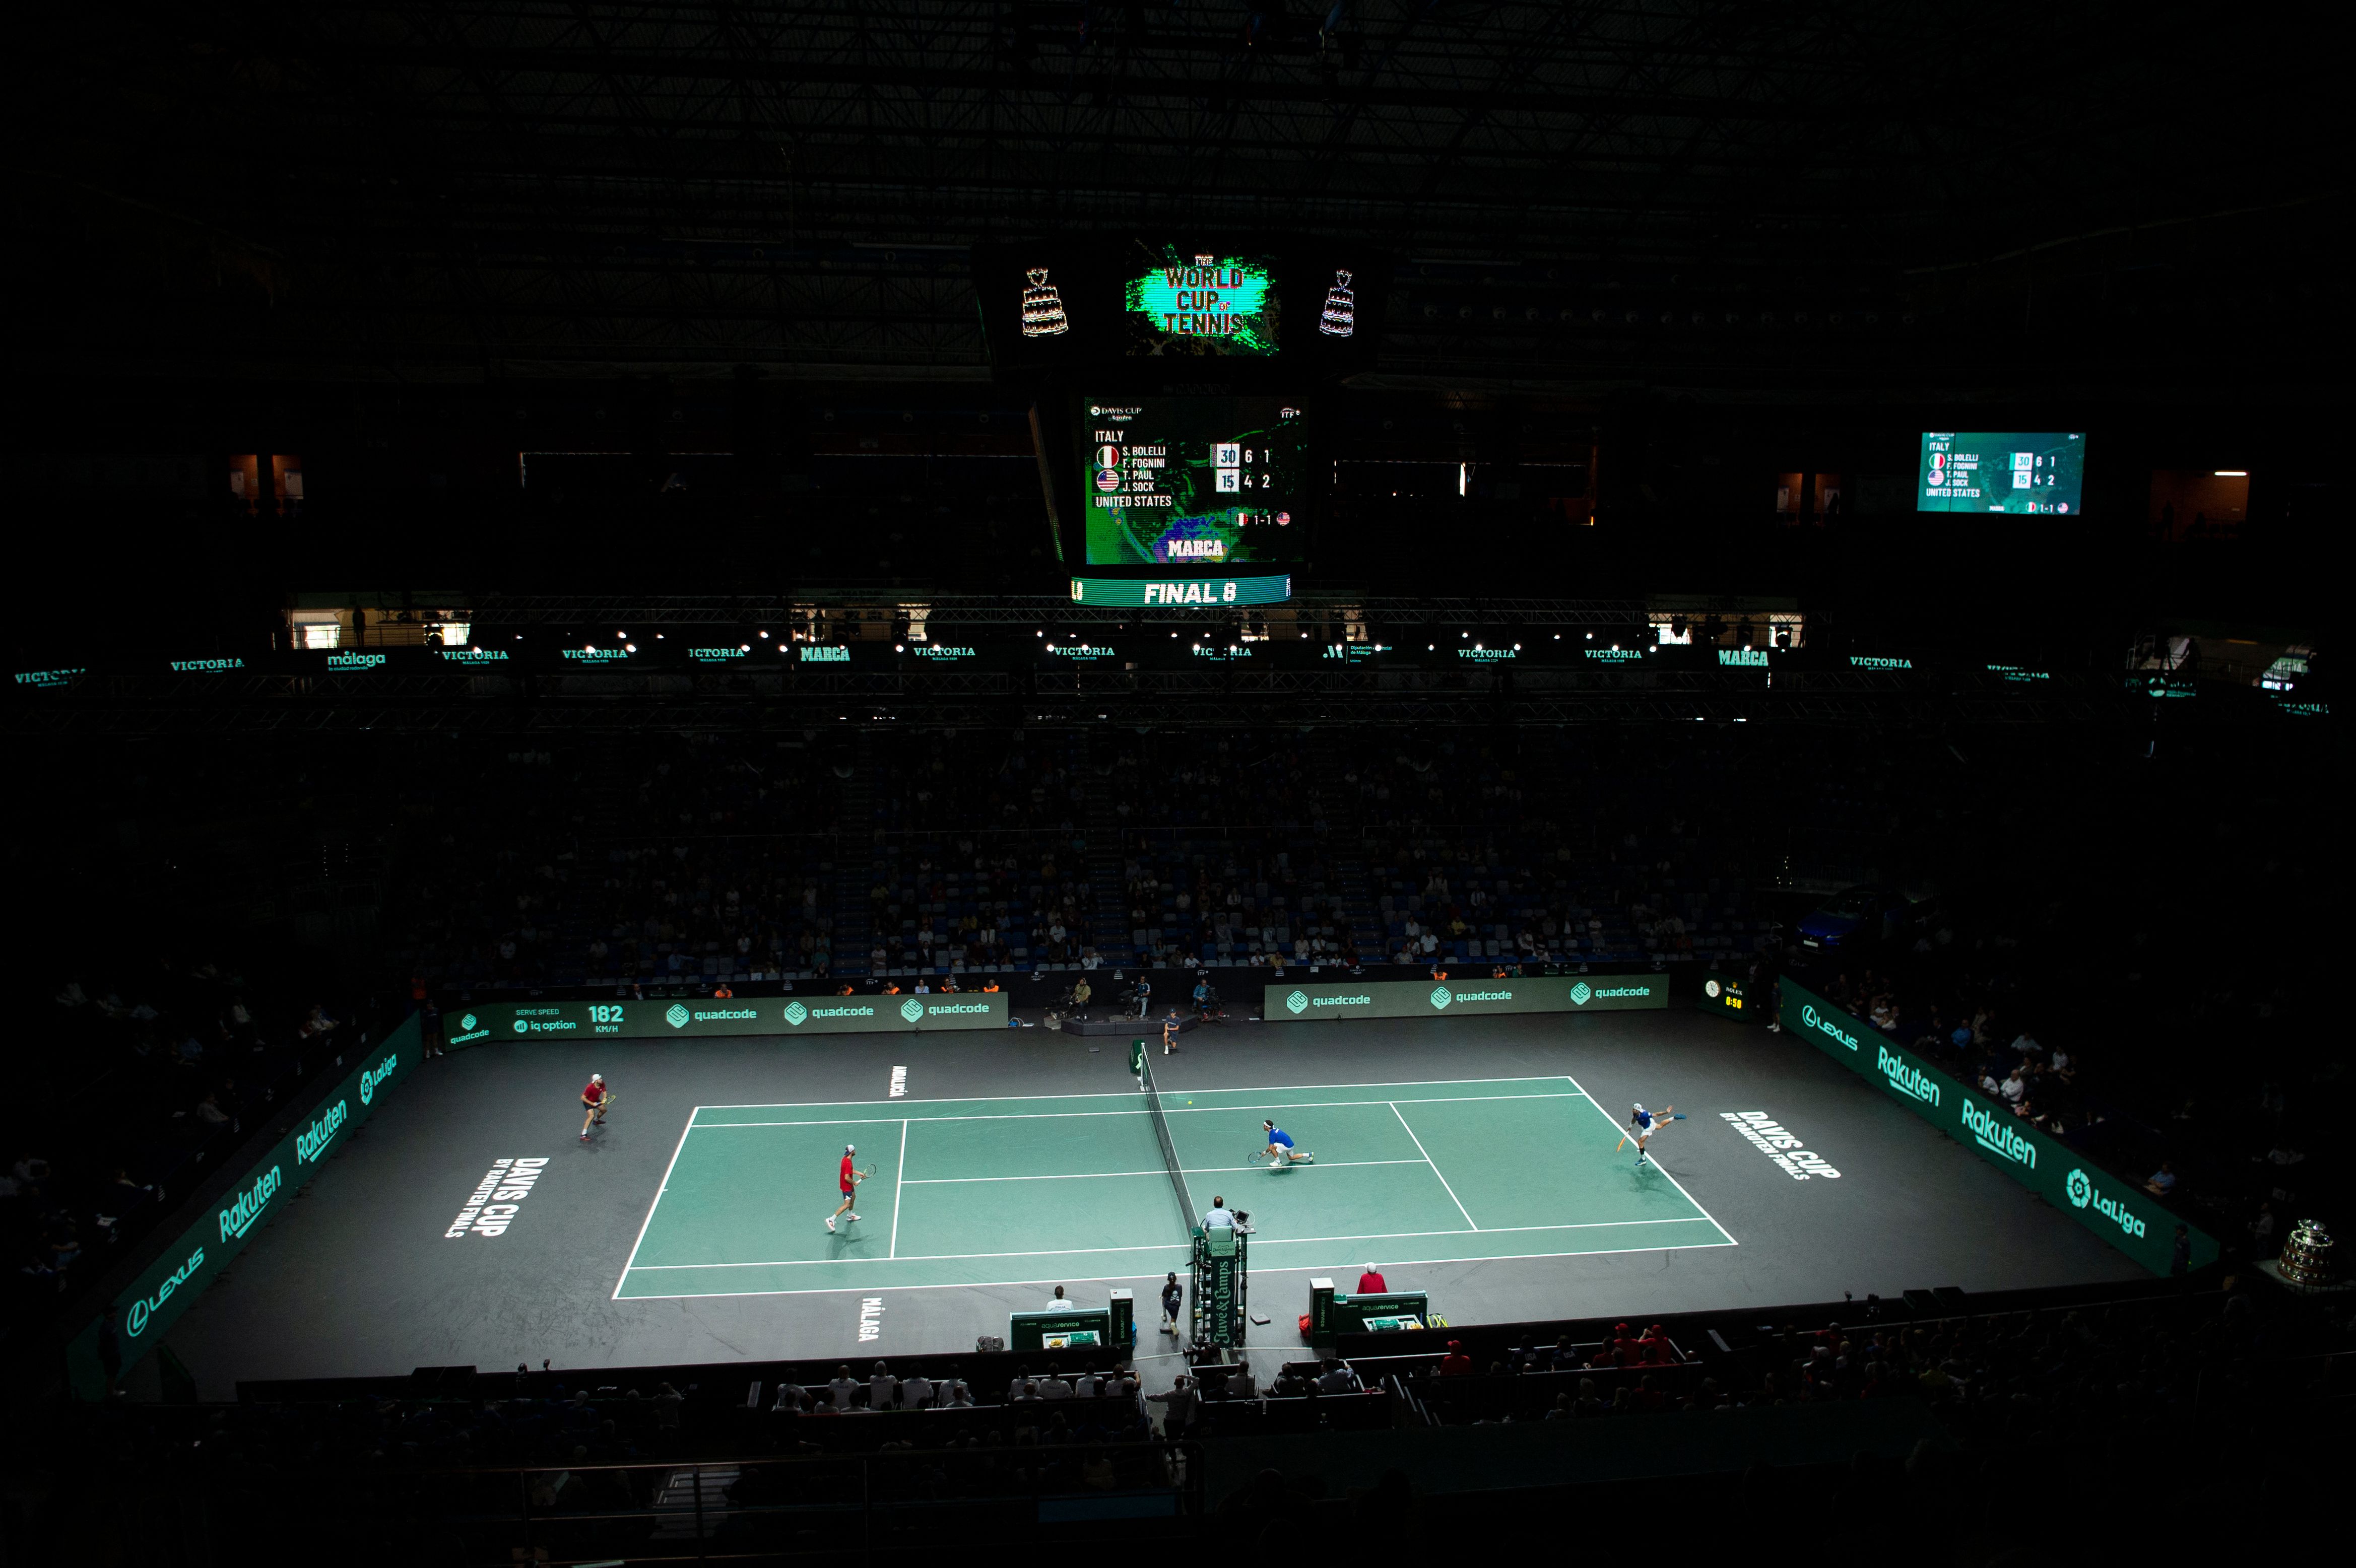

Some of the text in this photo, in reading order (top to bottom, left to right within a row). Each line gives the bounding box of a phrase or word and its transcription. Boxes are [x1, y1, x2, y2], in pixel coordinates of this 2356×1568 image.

[1164, 267, 1244, 289] WORLD
[1175, 291, 1220, 312] CUP
[1163, 313, 1244, 335] TENNIS
[1095, 430, 1124, 442] ITALY
[1123, 446, 1166, 456] S. BOLELLI
[1929, 442, 1950, 451] ITALY
[1221, 449, 1236, 463] 30
[1245, 450, 1253, 463] 6
[1264, 450, 1270, 463] 1
[1953, 454, 1979, 462] BOLELLI
[2018, 456, 2030, 466] 30
[2035, 456, 2043, 467] 6
[2050, 456, 2056, 467] 1
[1123, 458, 1165, 468] F. FOGNINI
[1123, 470, 1154, 480] T. PAUL
[1244, 474, 1253, 488] 4
[1263, 474, 1270, 488] 2
[1952, 471, 1969, 479] PAUL
[2017, 474, 2027, 485] 15
[2034, 474, 2041, 486] 4
[2048, 474, 2055, 486] 2
[1123, 482, 1154, 492] J. SOCK
[1222, 475, 1234, 489] 15
[1952, 479, 1969, 487] SOCK
[1926, 488, 1981, 498] UNITED STATES
[1095, 496, 1172, 507] UNITED STATES
[1168, 539, 1223, 557] MARCA
[1144, 582, 1237, 604] FINAL 8
[442, 651, 509, 660] VICTORIA
[562, 649, 628, 659] VICTORIA
[801, 646, 850, 661] MARCA
[913, 647, 976, 656] VICTORIA
[1055, 647, 1115, 656] VICTORIA
[1458, 649, 1516, 658] VICTORIA
[1585, 649, 1643, 658] VICTORIA
[1719, 650, 1770, 666] MARCA
[171, 658, 245, 671] VICTORIA
[1850, 656, 1913, 668] VICTORIA
[1456, 990, 1512, 1003] quadcode
[1595, 986, 1650, 999] quadcode
[1726, 986, 1743, 996] ROLEX
[1313, 994, 1371, 1008] quadcode
[588, 1005, 624, 1022] 182
[694, 1008, 757, 1022] quadcode
[812, 1006, 874, 1019] quadcode
[929, 1003, 990, 1016] quadcode
[543, 1019, 576, 1032] option
[595, 1025, 619, 1033] KM/H
[450, 1029, 490, 1045] quadcode
[1817, 1016, 1858, 1052] LEXUS
[373, 1053, 397, 1086] LaLiga
[1877, 1046, 1940, 1108] Rakuten
[297, 1099, 348, 1165] Rakuten
[1961, 1098, 2037, 1170] Rakuten
[1719, 1112, 1811, 1180] BY RAKUTEN FINALS
[1736, 1111, 1842, 1179] DAVIS CUP
[444, 1158, 514, 1238] BY RAKUTEN FINALS
[471, 1157, 550, 1237] DAVIS CUP
[219, 1165, 282, 1243] Rakuten
[2092, 1189, 2146, 1239] LaLiga
[149, 1247, 205, 1312] LEXUS
[1213, 1261, 1231, 1344] Juvé & Camps
[858, 1297, 886, 1342] MÁLAGA
